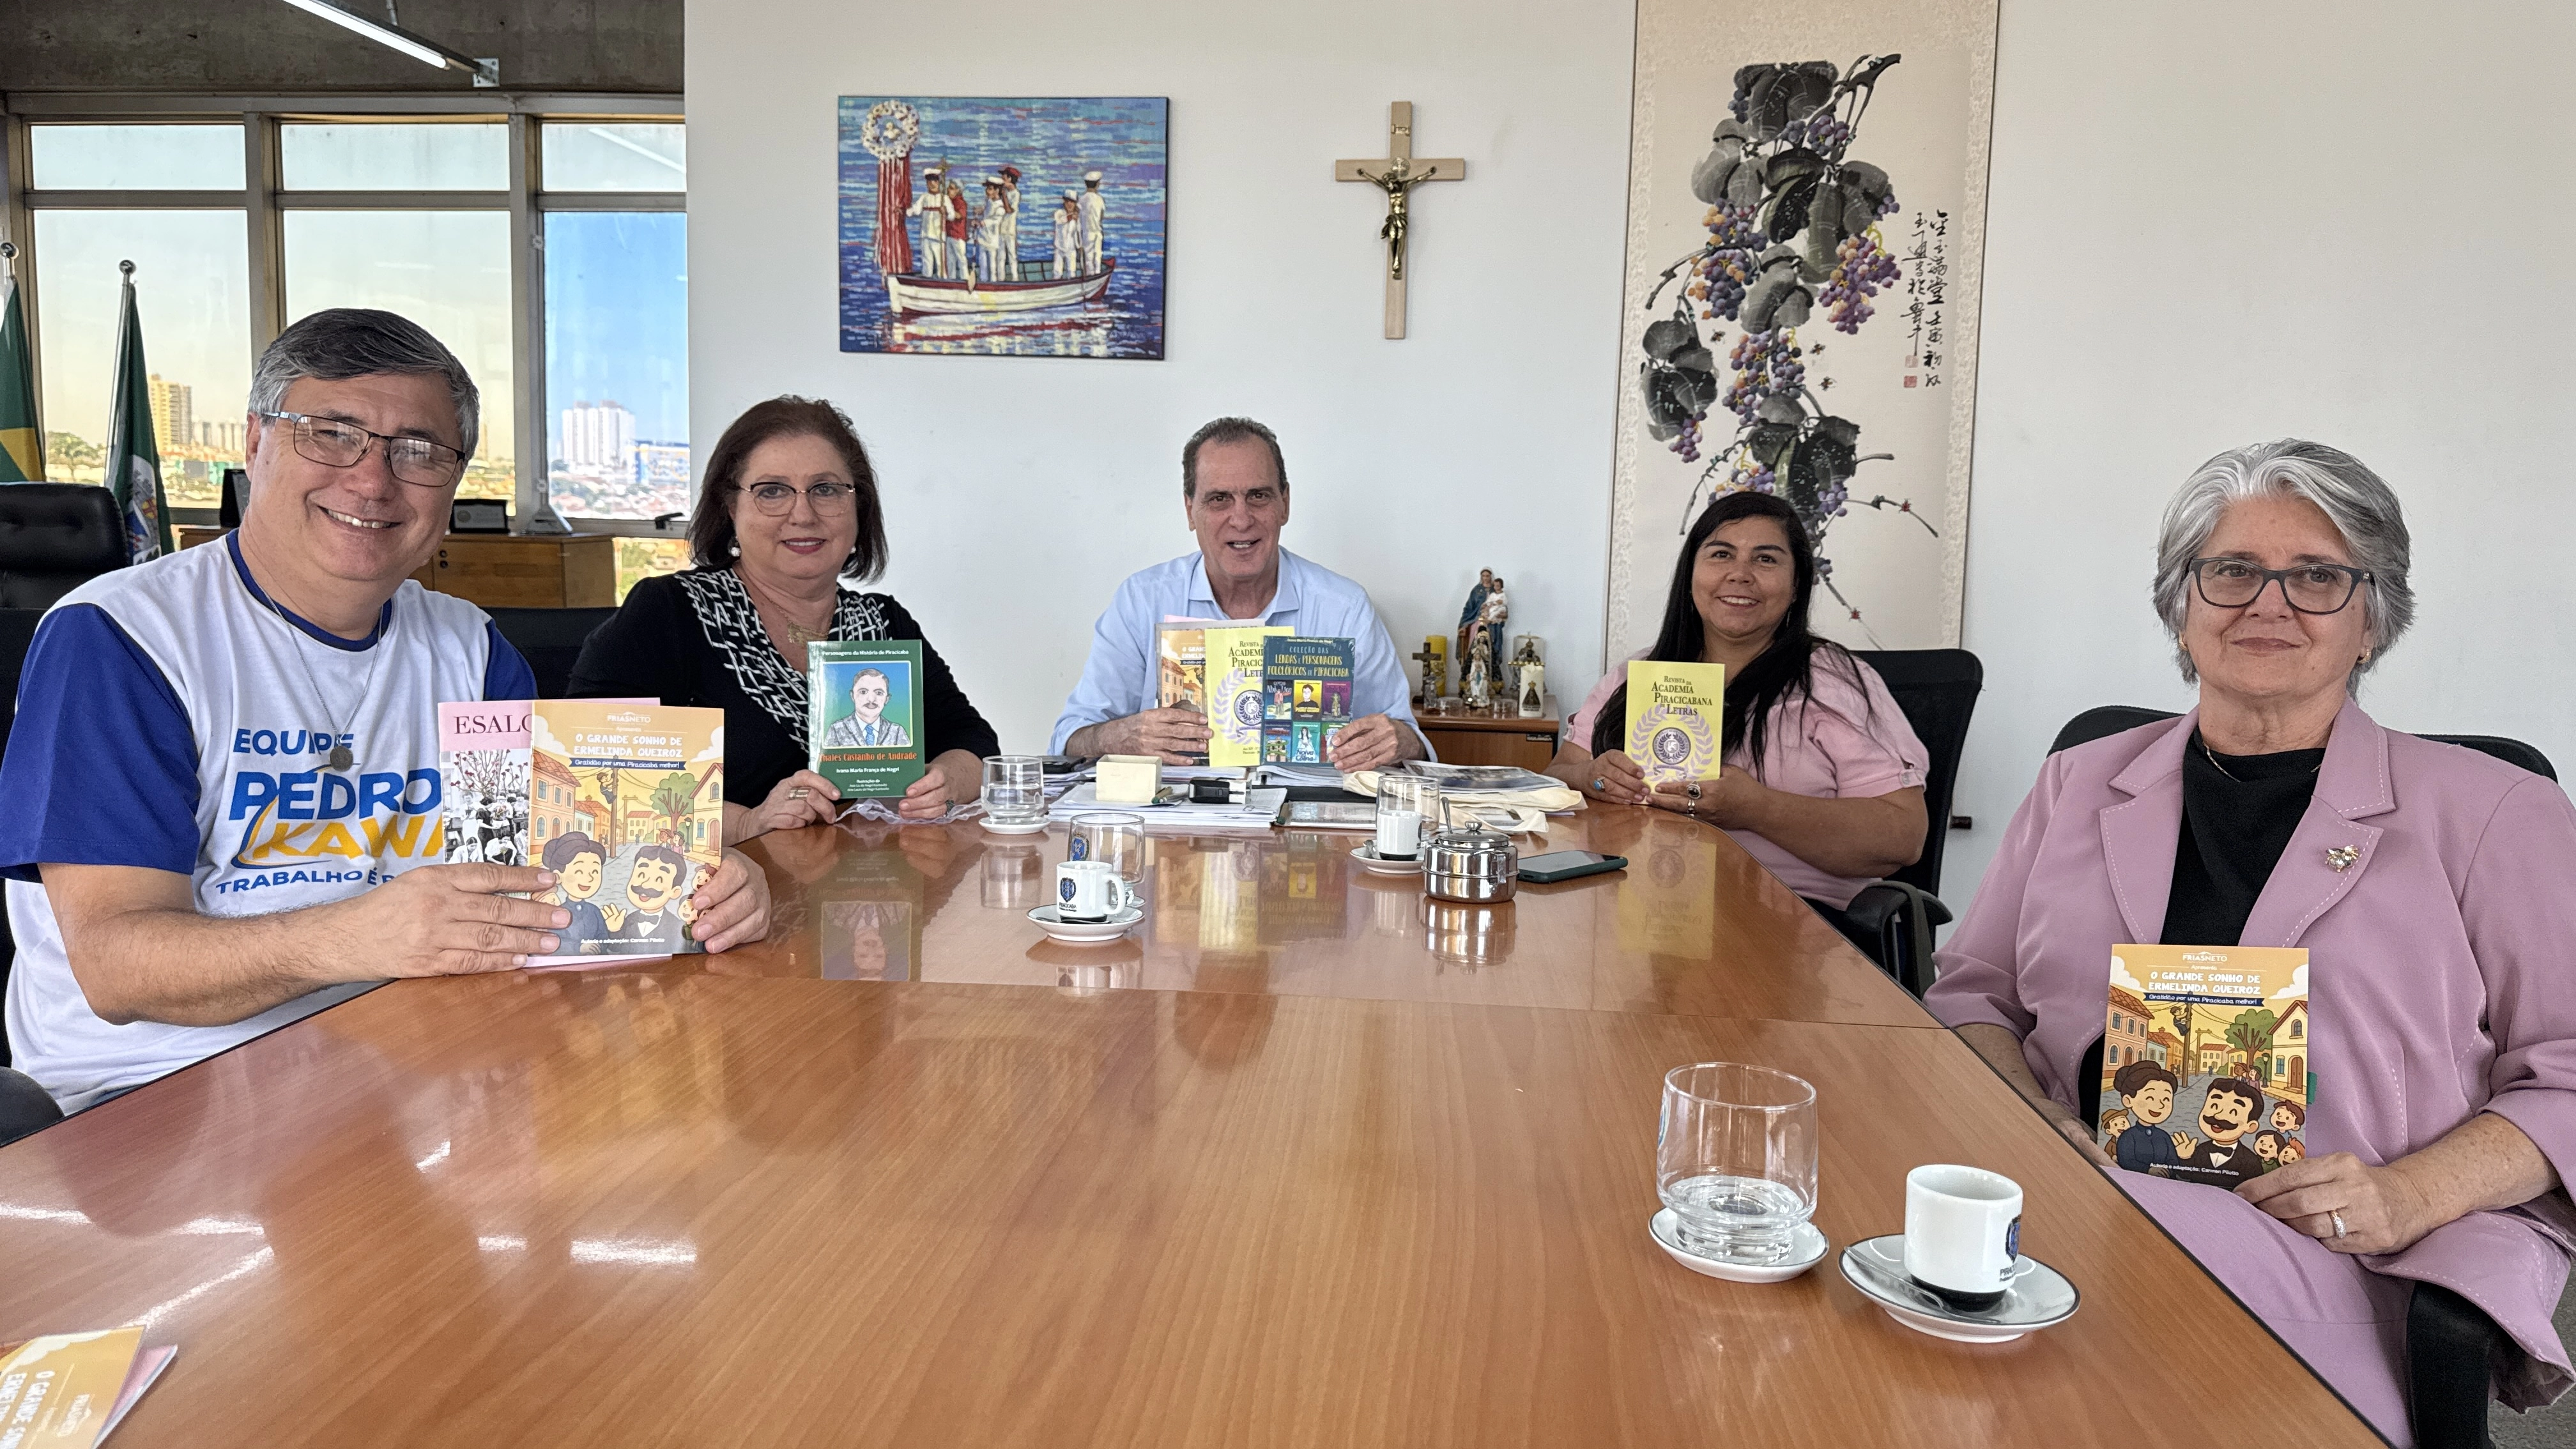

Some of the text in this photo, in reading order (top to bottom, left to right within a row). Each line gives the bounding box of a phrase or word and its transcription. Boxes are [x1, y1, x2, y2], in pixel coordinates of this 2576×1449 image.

[1228, 647, 1264, 657] ACADEMI
[1289, 646, 1315, 654] COLEÇÃO
[1232, 657, 1262, 667] PIRACIC
[1275, 654, 1297, 664] LENDAS
[1302, 655, 1342, 665] PERSONAGENS
[1314, 668, 1349, 677] PIRACICABA
[576, 733, 682, 746] O GRANDE SONHO DE
[574, 746, 683, 758] ERMELINDA QUEIROZ
[877, 752, 886, 760] de
[887, 751, 917, 760] Andrade
[229, 768, 441, 820] PEDRO
[216, 870, 362, 894] TRABALHO
[2150, 971, 2260, 984] O GRANDE SONHO DE
[2149, 982, 2261, 995] ERMELINDA QUEIROZ
